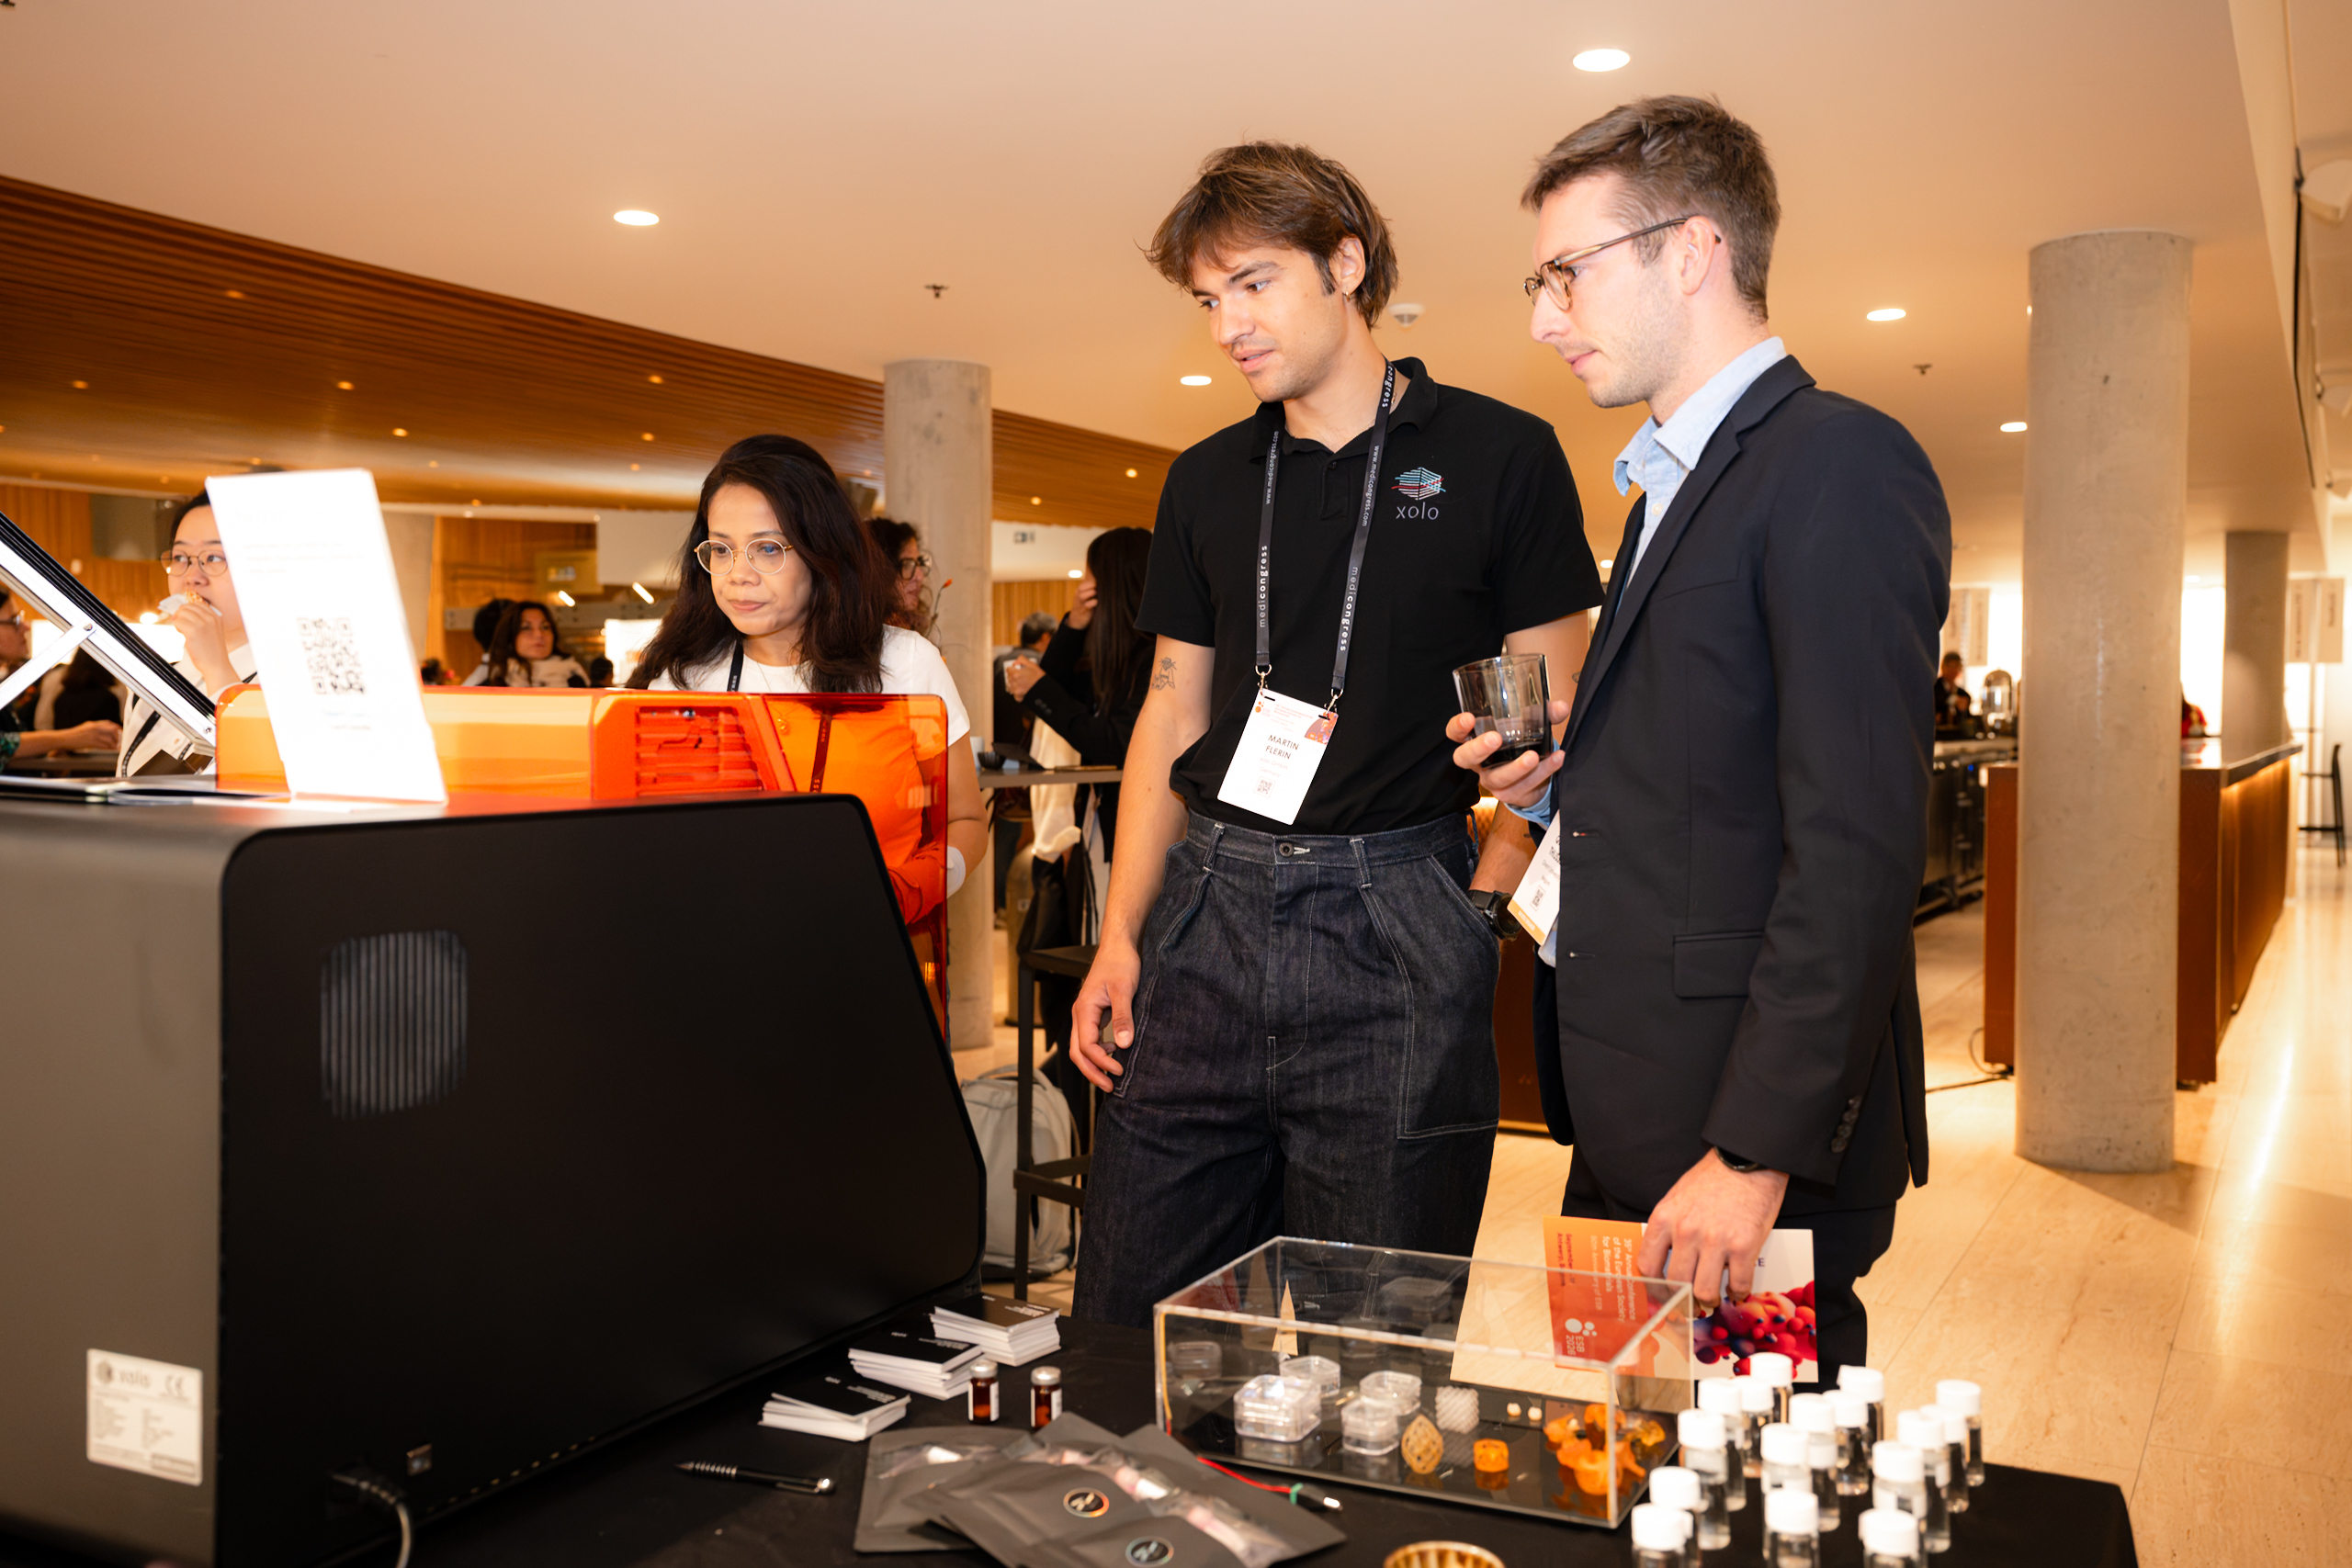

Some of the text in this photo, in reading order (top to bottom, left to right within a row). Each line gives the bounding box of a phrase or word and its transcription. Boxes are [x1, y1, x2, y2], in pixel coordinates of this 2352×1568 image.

[1265, 431, 1280, 505] www.medicongress.com
[1362, 445, 1380, 527] www.medicongress.com
[1395, 501, 1440, 521] xolo
[1268, 735, 1299, 750] MARTIN
[1265, 745, 1292, 760] FLERIN
[1602, 1235, 1611, 1247] for
[1613, 1247, 1622, 1259] the
[1617, 1294, 1626, 1323] Society
[1566, 1335, 1577, 1356] 2026
[1575, 1335, 1585, 1353] ESB
